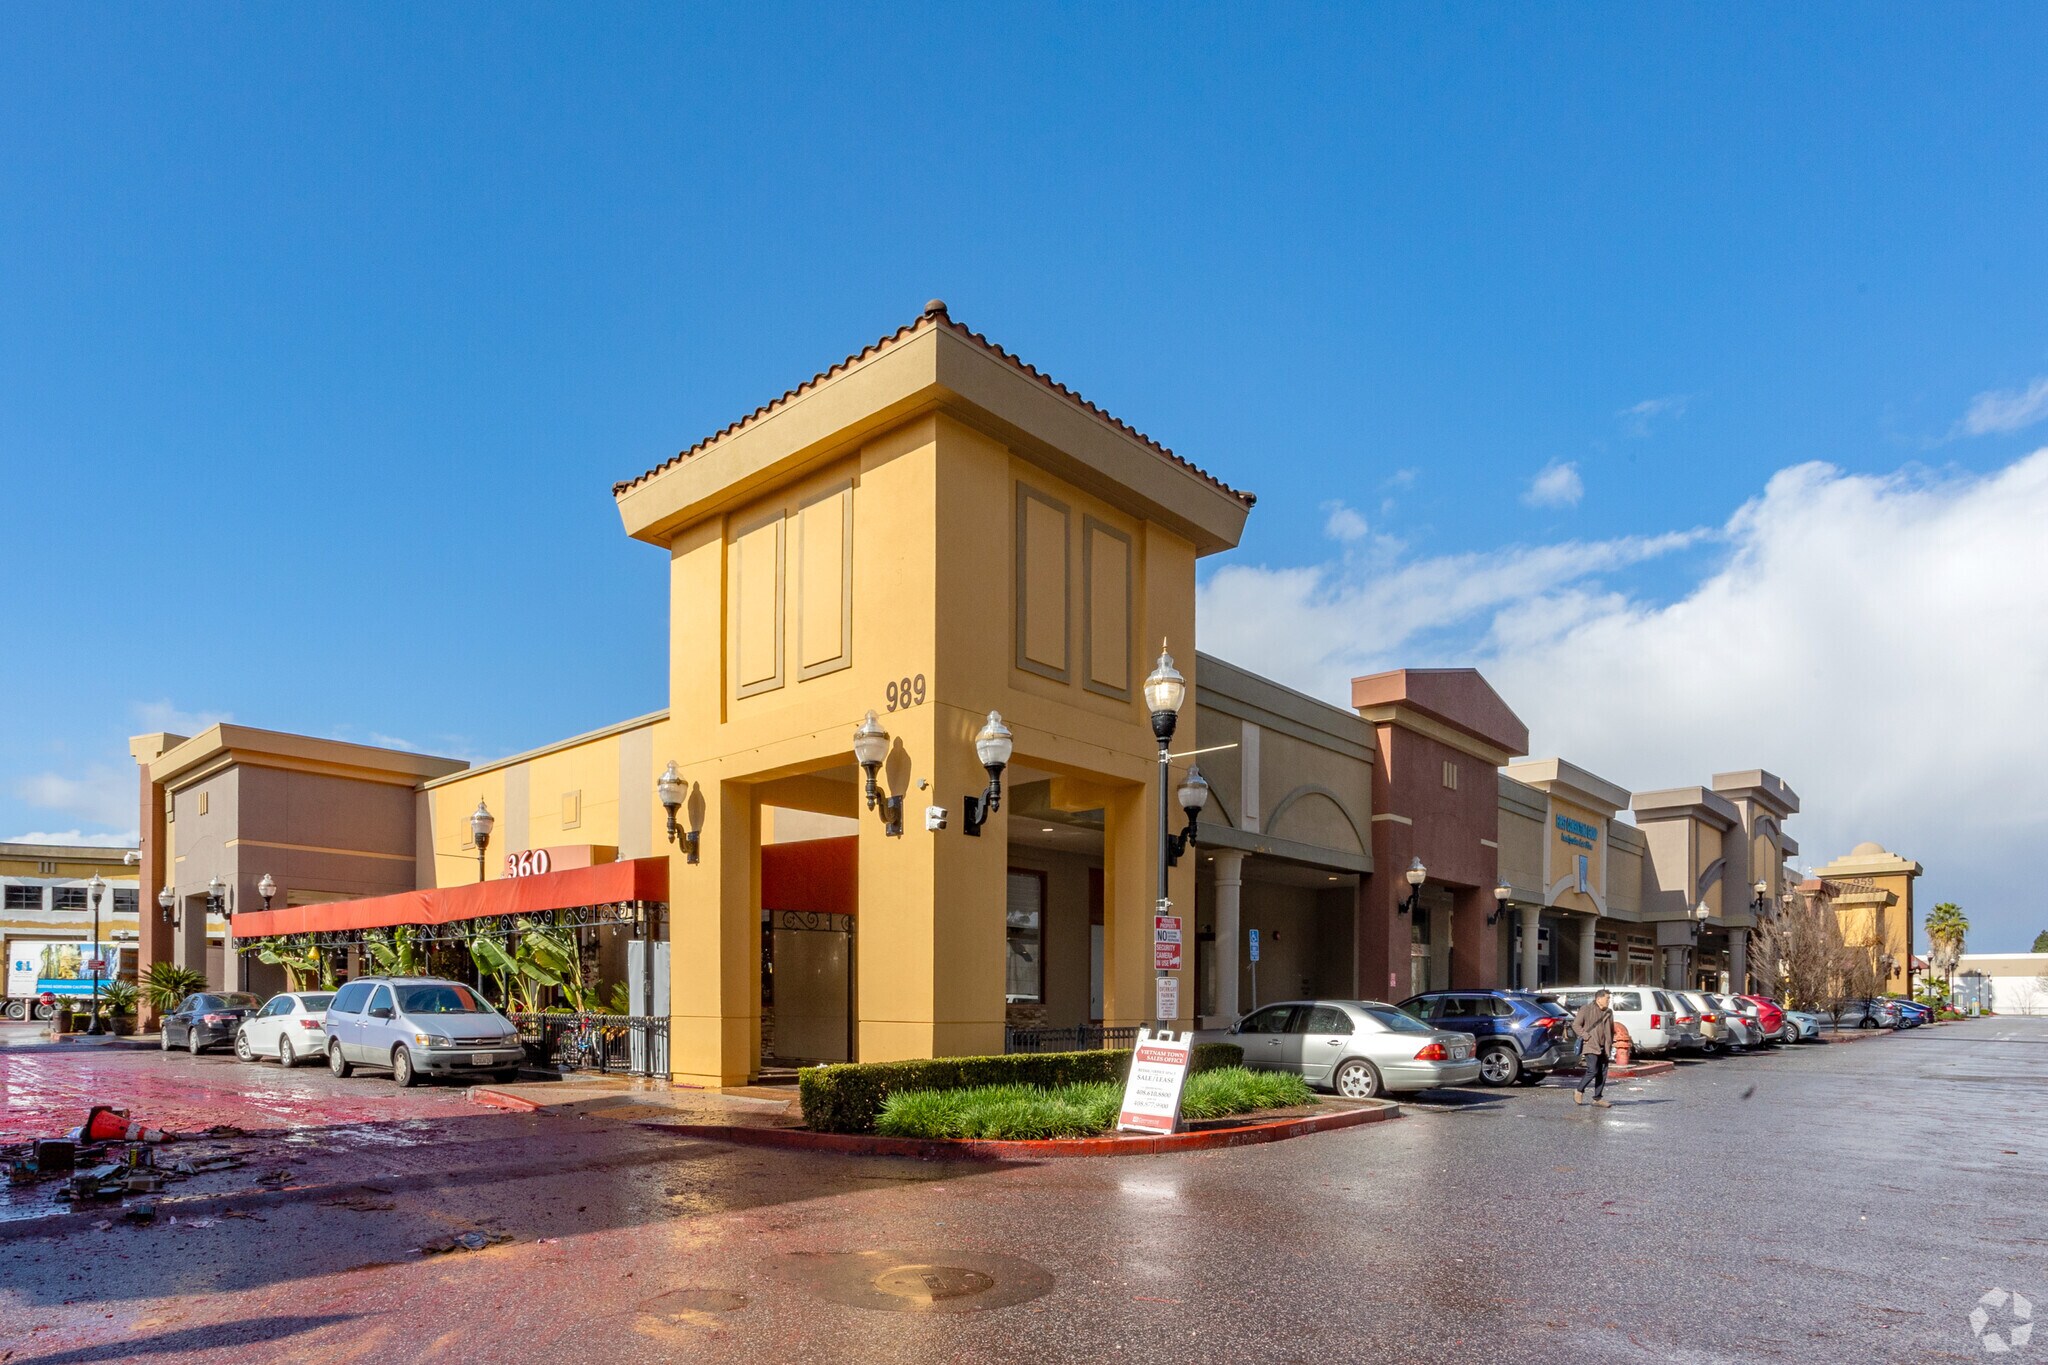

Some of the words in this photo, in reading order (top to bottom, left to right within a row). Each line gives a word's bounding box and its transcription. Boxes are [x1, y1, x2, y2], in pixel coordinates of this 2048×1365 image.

[886, 673, 926, 713] 989
[507, 848, 551, 878] 360
[1853, 877, 1874, 888] 959
[1157, 930, 1167, 941] NO
[1156, 951, 1173, 959] CAMERA
